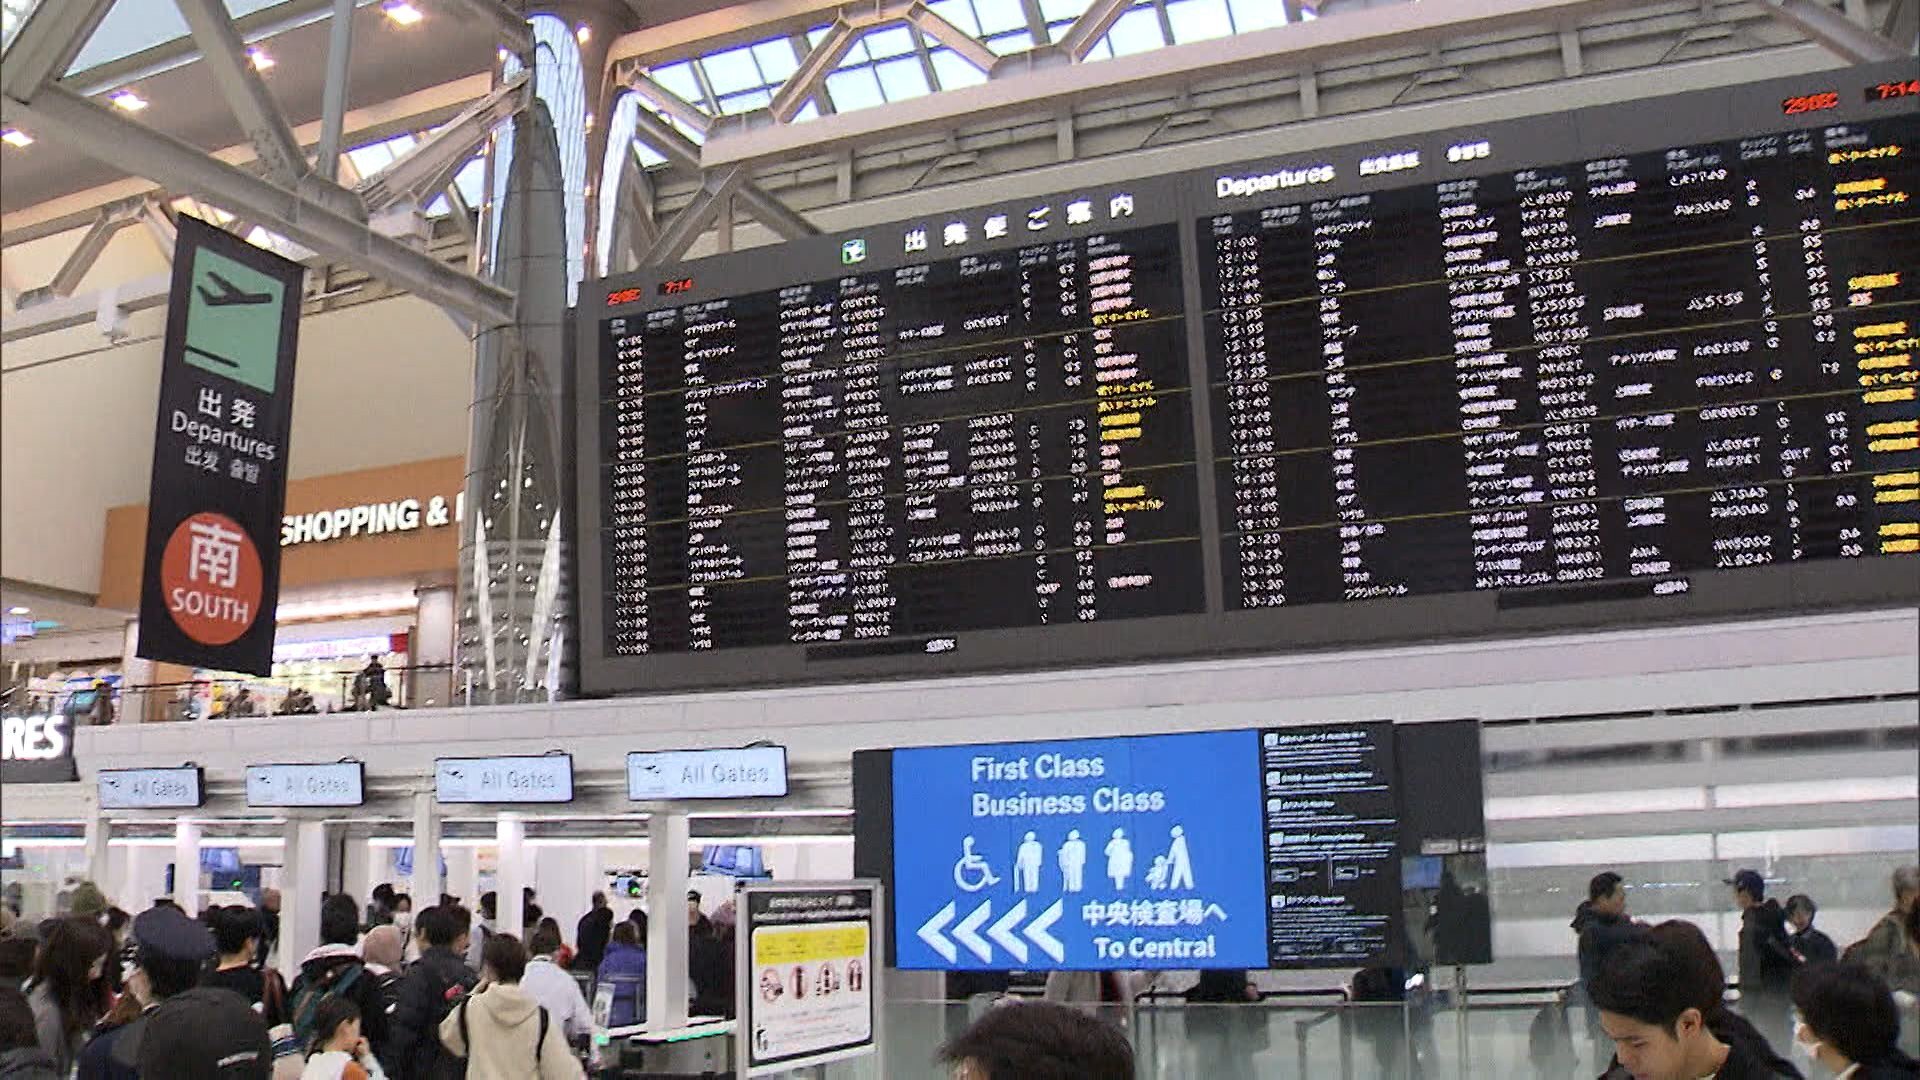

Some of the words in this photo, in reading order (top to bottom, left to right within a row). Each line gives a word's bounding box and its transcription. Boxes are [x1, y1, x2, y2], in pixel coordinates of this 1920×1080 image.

[1215, 163, 1336, 198] Departures
[172, 410, 276, 461] Departures
[280, 499, 420, 547] SHOPPING
[426, 495, 448, 527] &
[188, 522, 243, 589] 南
[170, 587, 250, 624] SOUTH
[482, 770, 503, 789] All
[507, 770, 556, 790] Gates
[681, 763, 706, 786] All
[711, 762, 771, 785] Gates
[971, 756, 1029, 783] First
[1034, 752, 1106, 780] Class
[152, 781, 189, 798] Gates
[307, 776, 352, 794] Gates
[971, 791, 1087, 818] Business
[1092, 786, 1167, 814] Class
[1081, 898, 1229, 928] 中央検査場へ
[1093, 937, 1125, 960] To
[1129, 935, 1217, 960] Central
